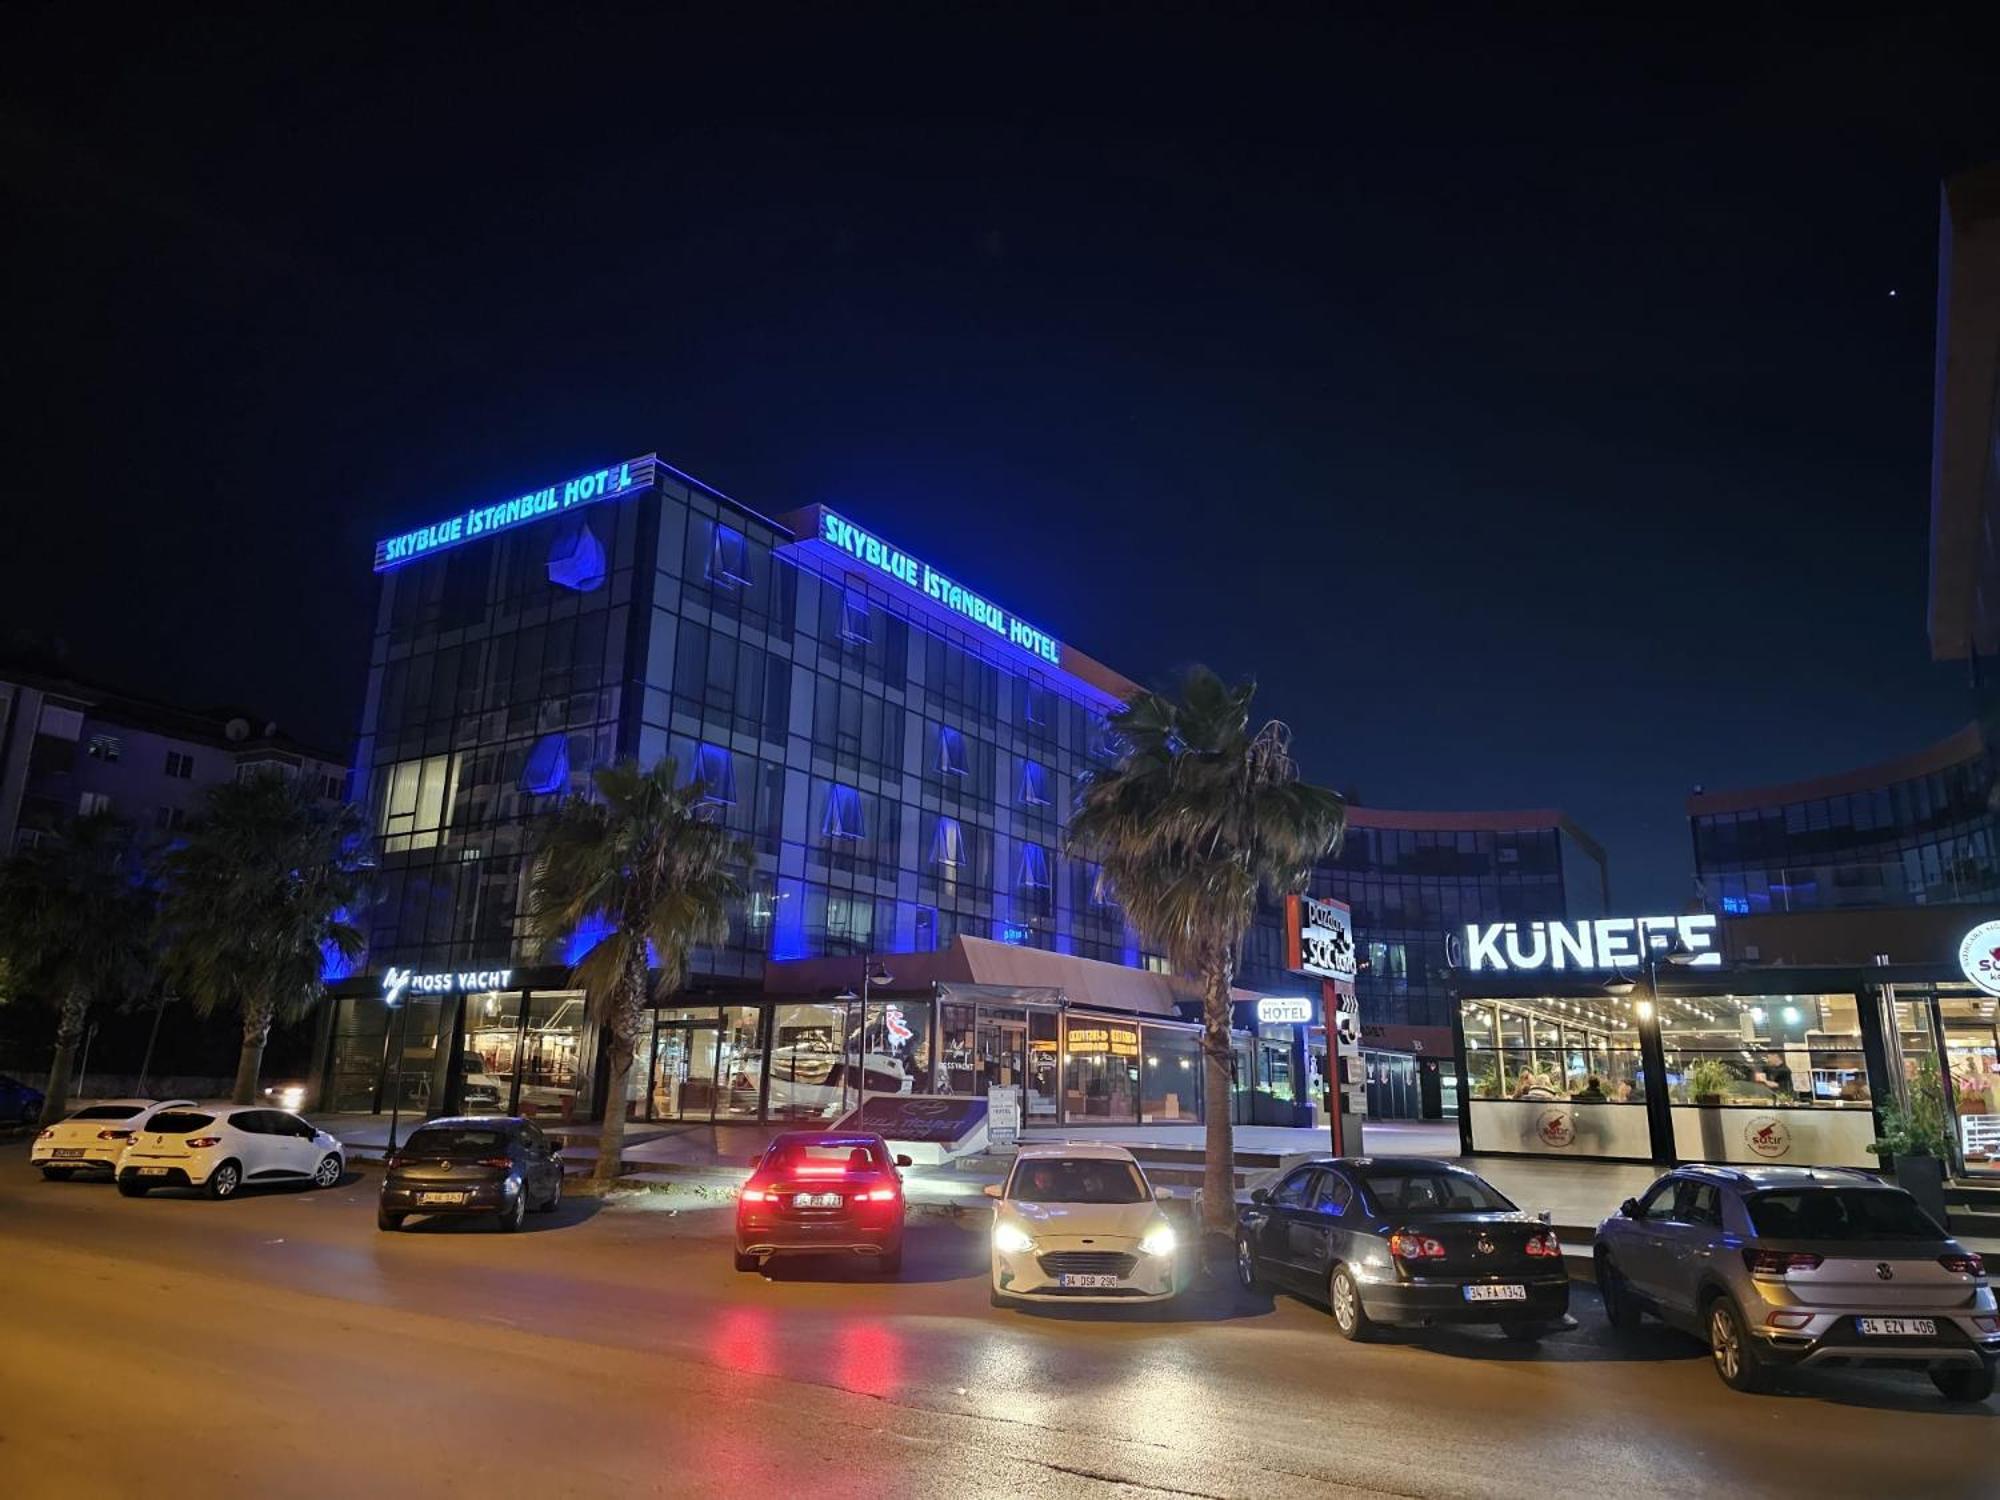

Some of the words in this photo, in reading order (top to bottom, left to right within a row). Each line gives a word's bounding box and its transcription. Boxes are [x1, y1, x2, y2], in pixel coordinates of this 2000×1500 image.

[385, 517, 463, 560] SKYBLUE
[466, 487, 559, 535] İSTANBUL
[564, 463, 632, 507] HOTEL
[825, 514, 918, 586] SKYBLUE
[923, 573, 1006, 635] İSTANBUL
[1009, 618, 1060, 664] HOTEL
[1466, 914, 1722, 971] KÜNEFE
[458, 970, 512, 991] YACHT
[1262, 1007, 1307, 1020] HOTEL
[1066, 1275, 1075, 1285] 34
[1471, 1287, 1482, 1298] 34
[1486, 1287, 1498, 1298] FA
[1863, 1320, 1878, 1333] 34
[1912, 1320, 1934, 1333] 406
